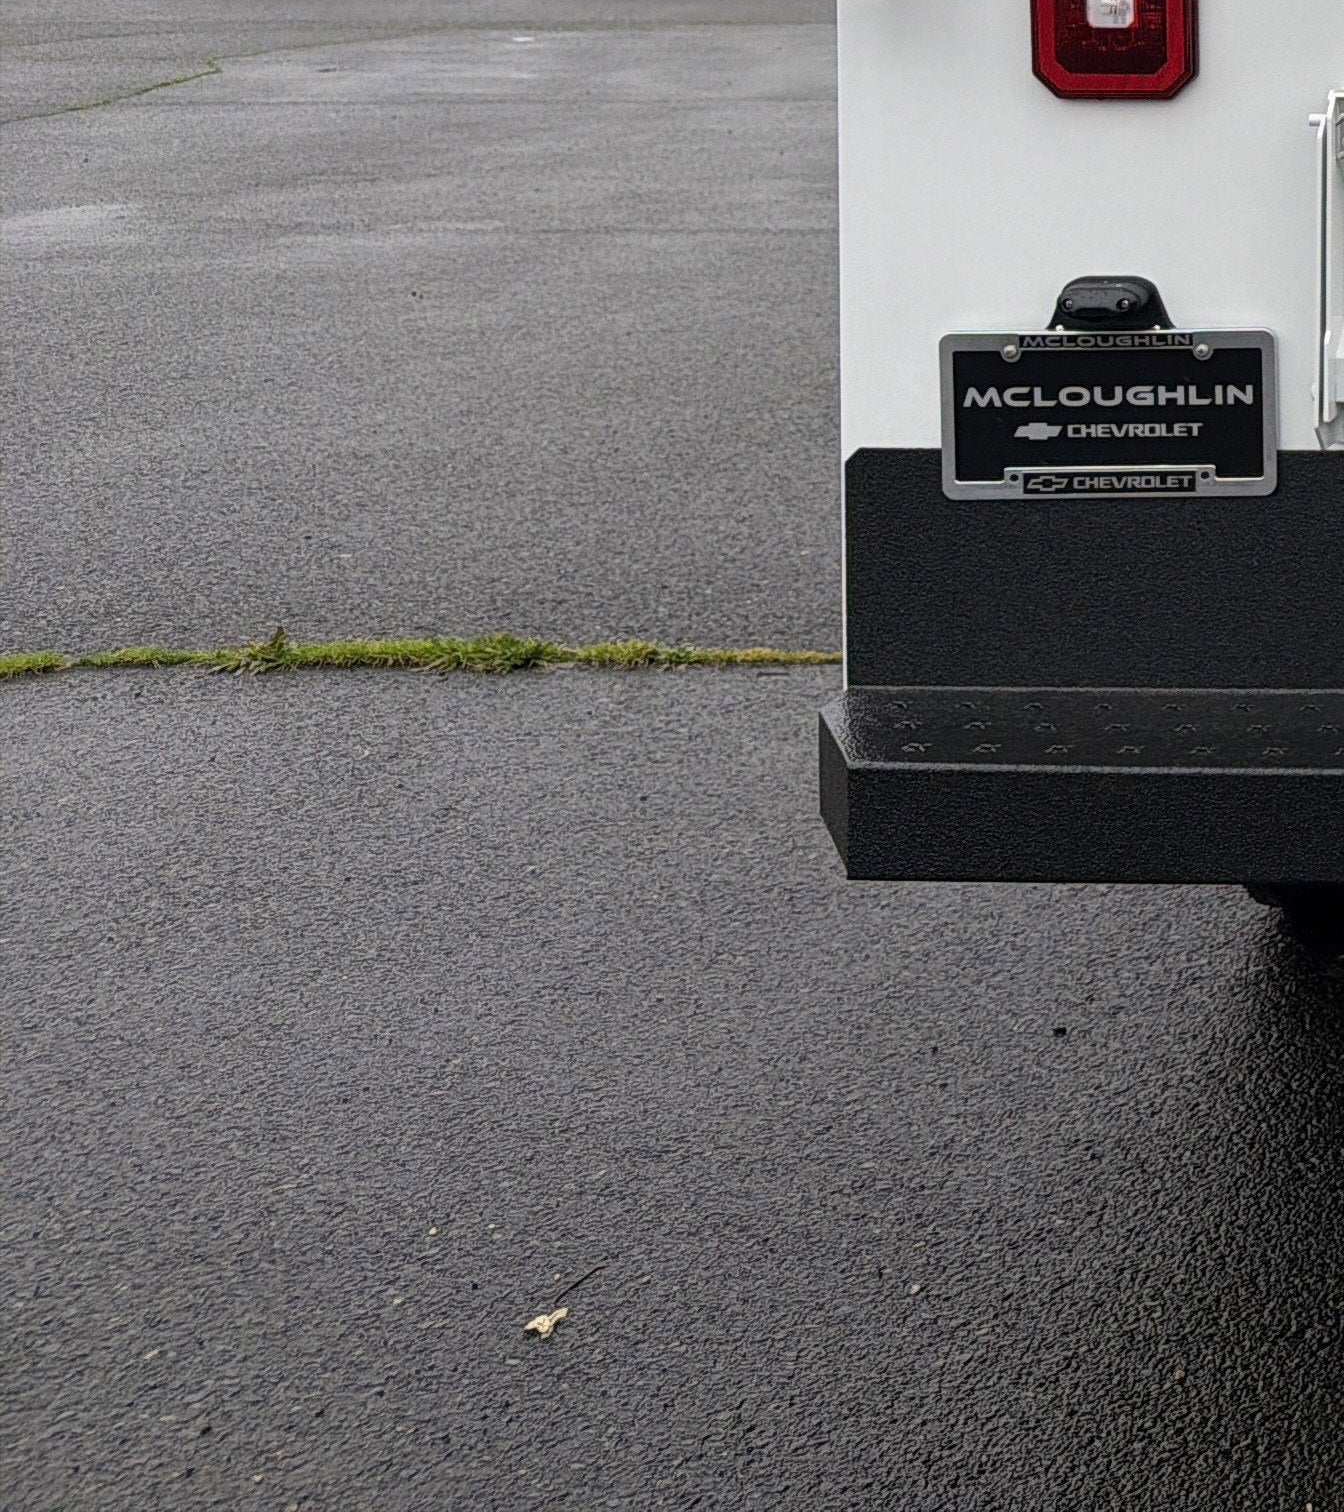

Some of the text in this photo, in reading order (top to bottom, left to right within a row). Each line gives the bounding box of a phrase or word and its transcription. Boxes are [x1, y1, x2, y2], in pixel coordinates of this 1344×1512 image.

[1022, 334, 1192, 348] MCLOUGHLIN
[962, 384, 1254, 409] MCLOUGHLIN
[1067, 422, 1203, 439] CHEVROLET
[1072, 475, 1194, 490] CHEVROLET
